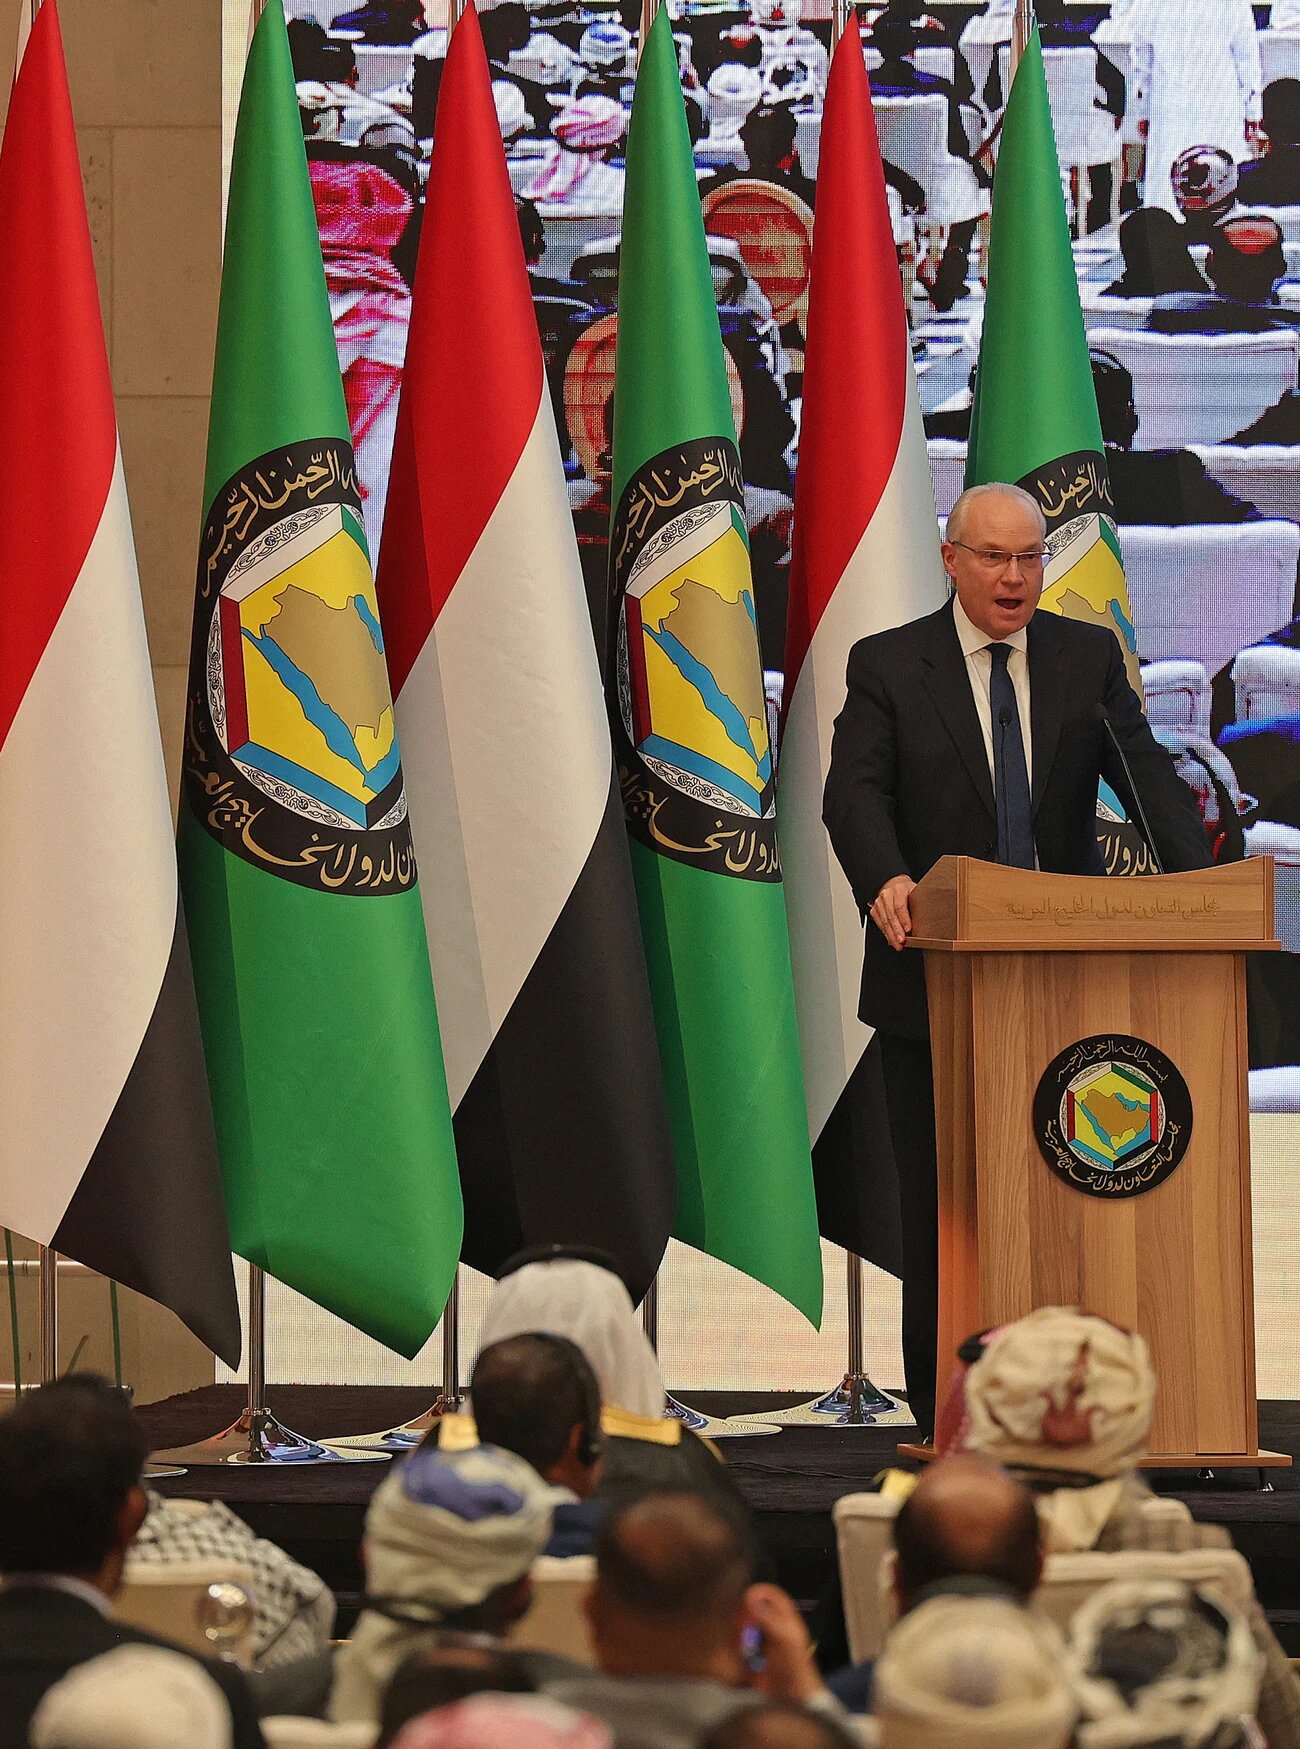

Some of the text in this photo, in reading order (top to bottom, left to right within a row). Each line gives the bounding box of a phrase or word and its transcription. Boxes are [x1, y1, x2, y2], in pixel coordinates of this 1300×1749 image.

[1005, 896, 1051, 921] العربية
[1054, 895, 1094, 927] الخليج
[1134, 895, 1181, 920] التعاون
[1181, 894, 1220, 921] مجلس
